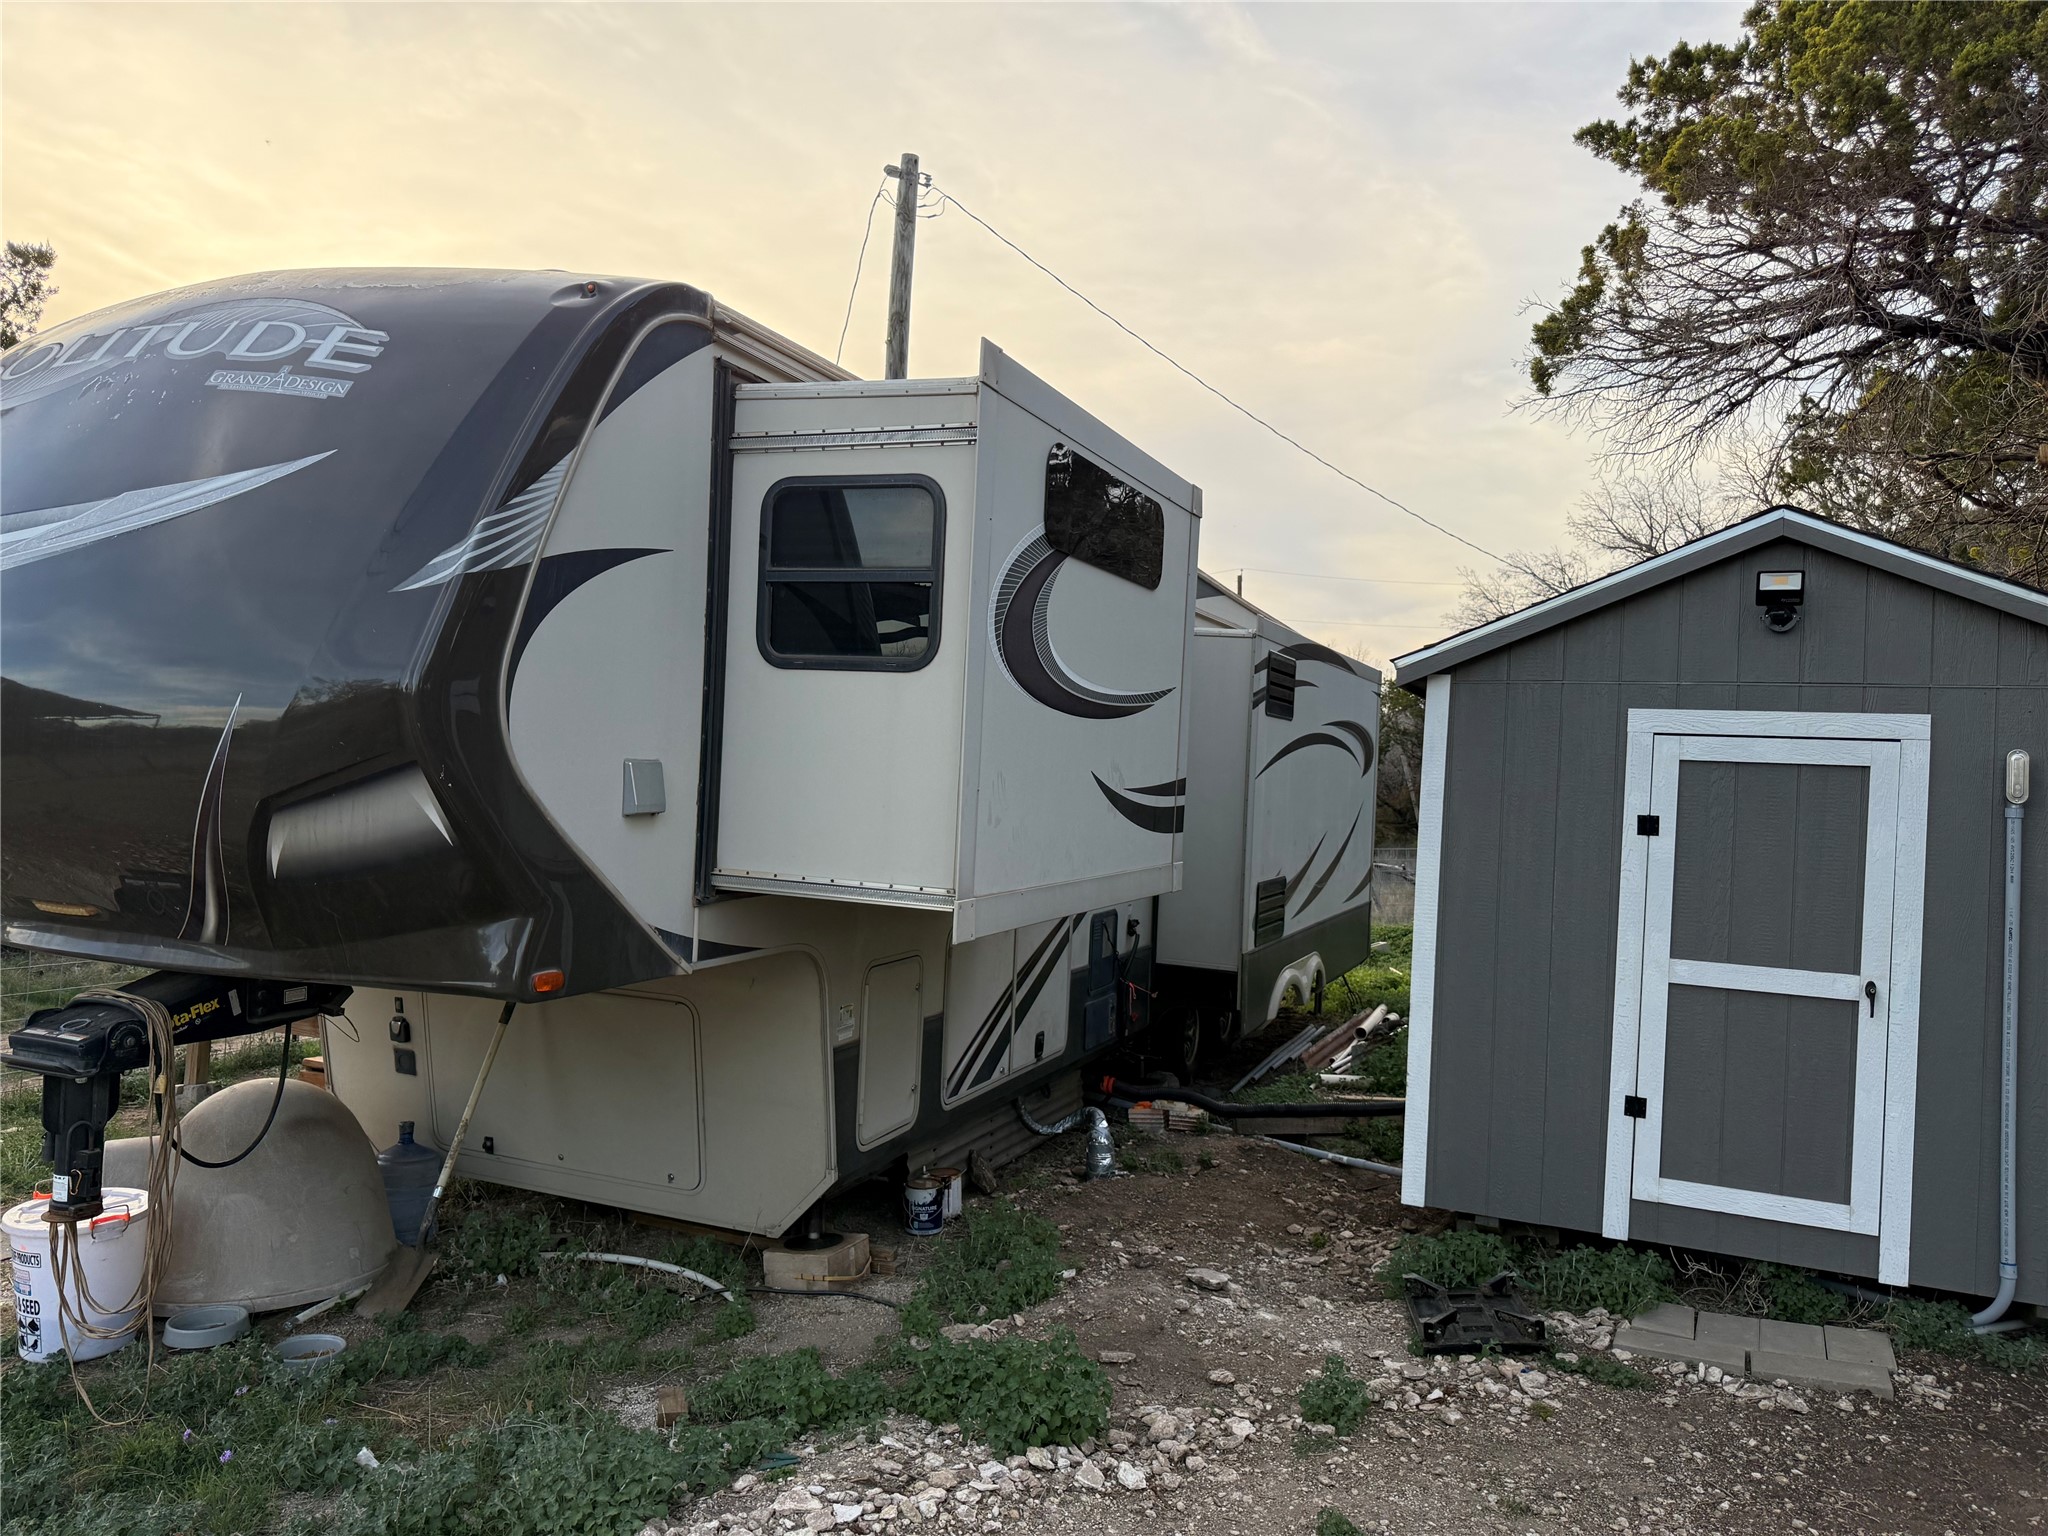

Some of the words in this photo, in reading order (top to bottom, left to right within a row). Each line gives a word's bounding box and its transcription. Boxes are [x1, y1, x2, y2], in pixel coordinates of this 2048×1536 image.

[210, 371, 270, 385] GRAND
[284, 376, 348, 394] DESIGN
[22, 1298, 40, 1316] SEED
